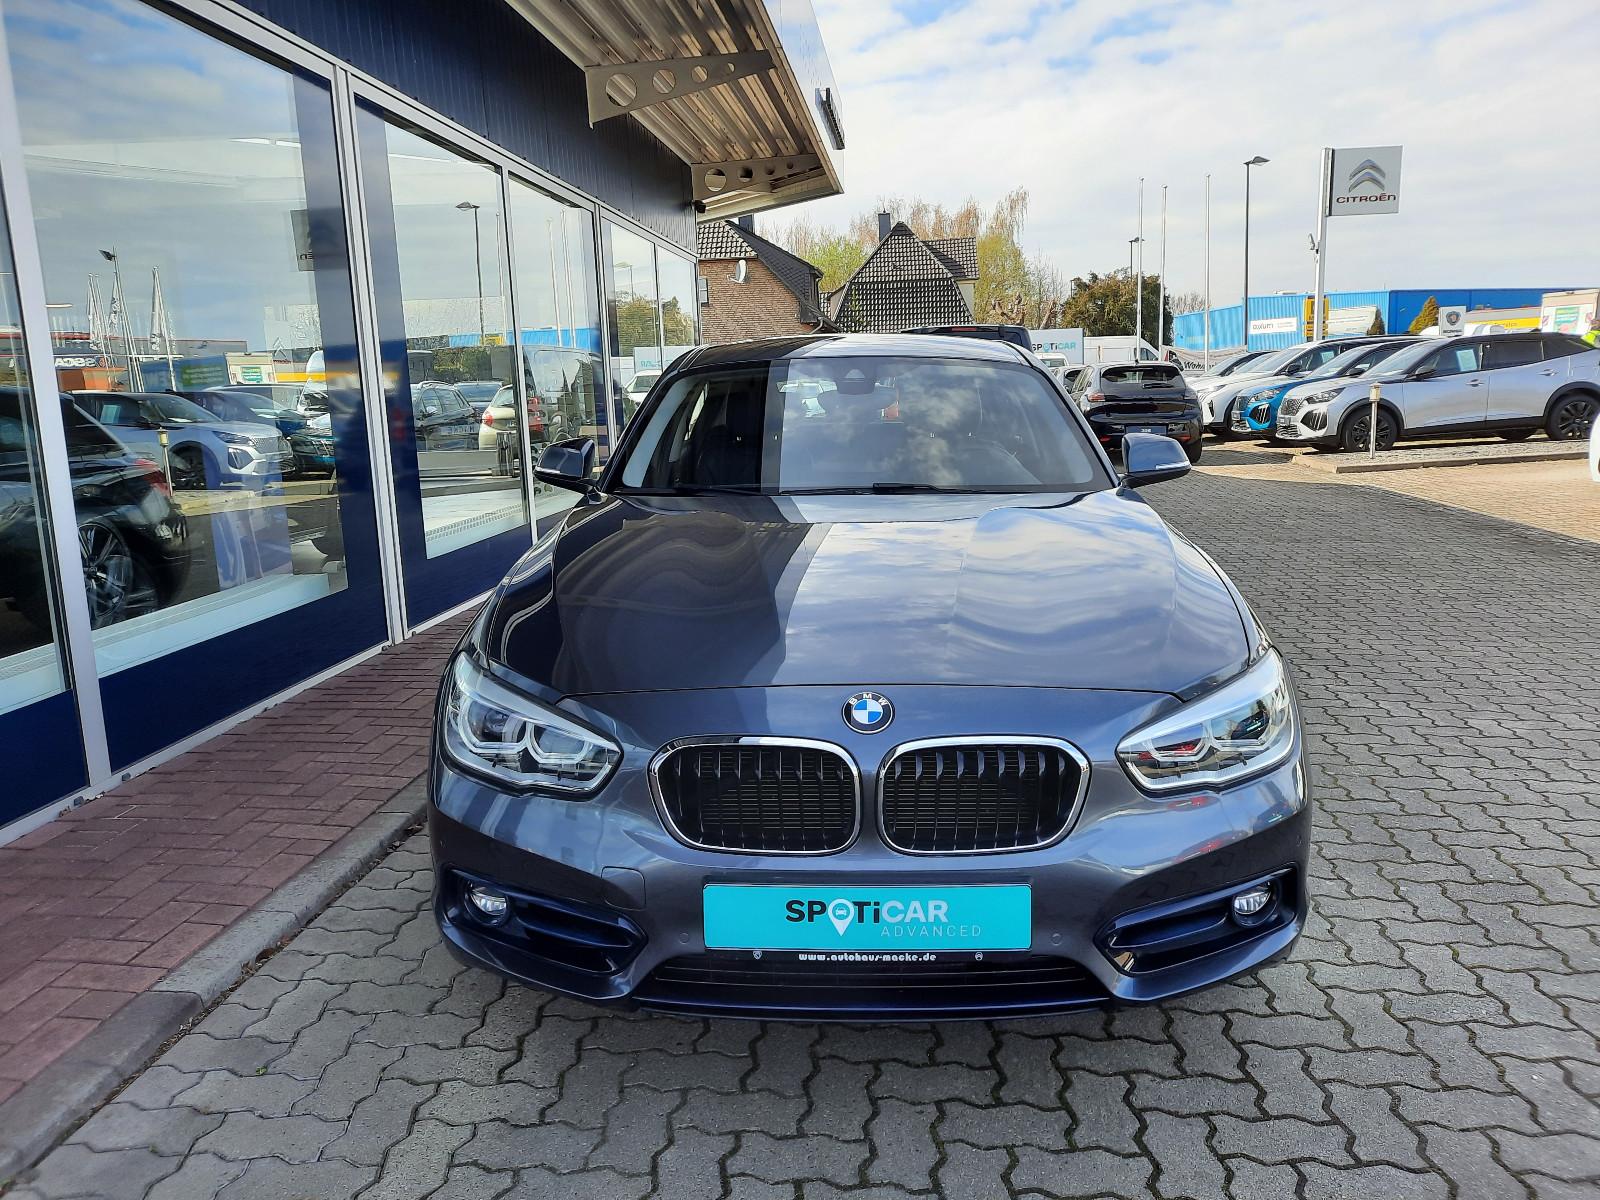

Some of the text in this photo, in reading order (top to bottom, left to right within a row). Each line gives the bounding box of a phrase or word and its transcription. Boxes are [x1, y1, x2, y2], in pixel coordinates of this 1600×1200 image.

[849, 693, 889, 705] BMW
[785, 899, 948, 936] SPOTiCAR
[881, 925, 981, 937] ADVANCED
[798, 952, 937, 962] www.autohaus-macke.de
